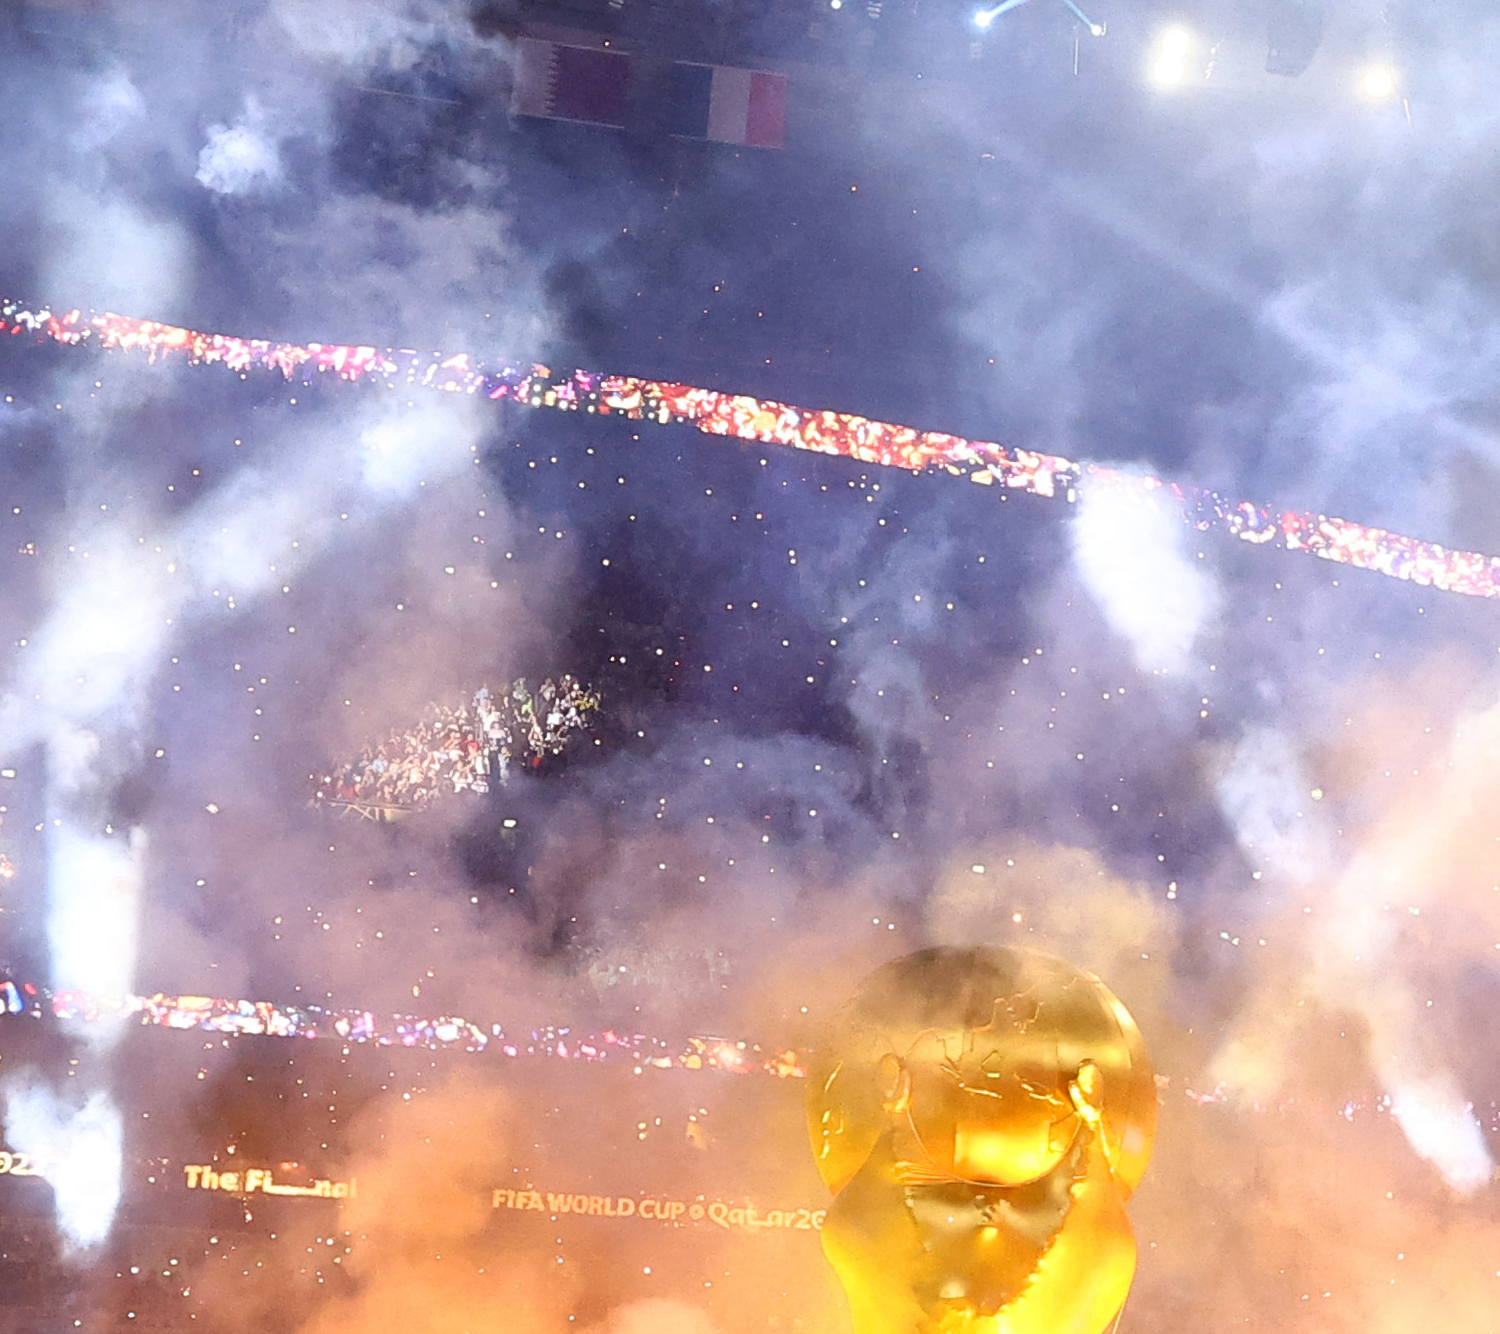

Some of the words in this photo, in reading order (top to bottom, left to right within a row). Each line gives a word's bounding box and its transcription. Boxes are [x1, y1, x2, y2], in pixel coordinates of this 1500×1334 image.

[184, 1165, 239, 1192] The
[245, 1168, 357, 1198] Final
[492, 1189, 545, 1212] FIFA
[547, 1192, 635, 1217] WORLD
[638, 1198, 686, 1220] CUP
[707, 1201, 827, 1230] Qatar20
